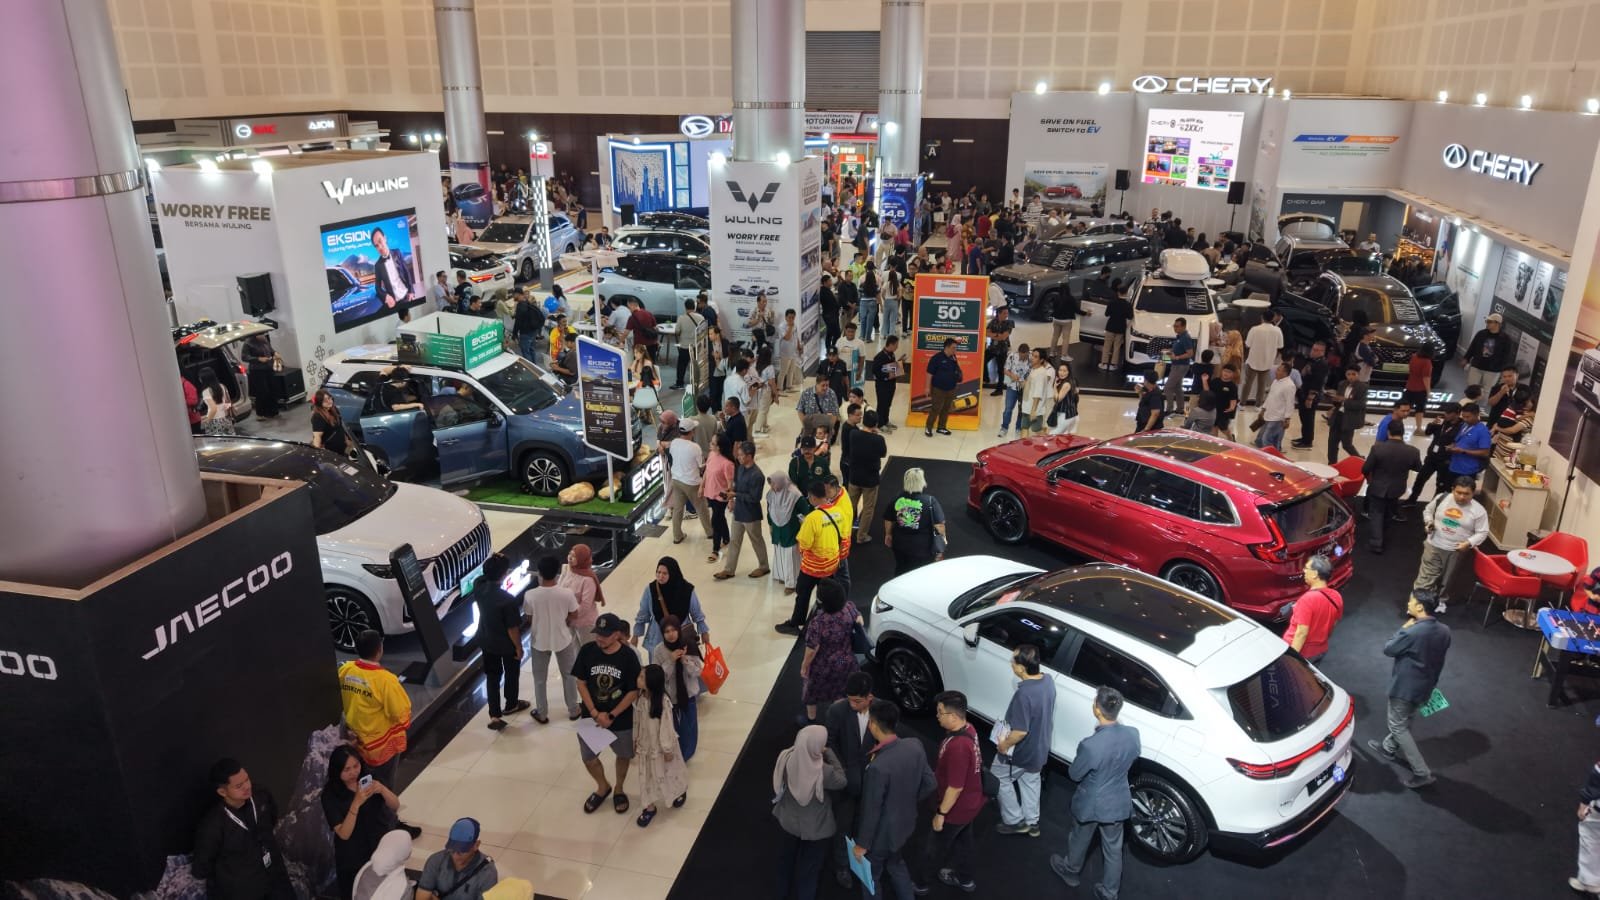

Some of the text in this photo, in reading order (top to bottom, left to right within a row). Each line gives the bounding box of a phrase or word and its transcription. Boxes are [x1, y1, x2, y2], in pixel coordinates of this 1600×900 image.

[1176, 77, 1271, 94] CHERY
[1087, 126, 1102, 134] EV
[928, 146, 937, 157] A
[1470, 150, 1540, 185] CHERY
[352, 176, 409, 197] WULING
[161, 203, 271, 222] WORRY FREE
[184, 220, 252, 230] BERSAMA WULING
[725, 216, 782, 225] WULING
[327, 230, 371, 246] EKSION
[727, 232, 780, 242] WORRY FREE
[938, 305, 966, 320] 50%
[471, 329, 498, 346] EKSION
[587, 359, 615, 367] EKSION
[632, 454, 663, 494] EKSI
[142, 551, 292, 660] JAECOO
[590, 665, 622, 680] SINGAPORE
